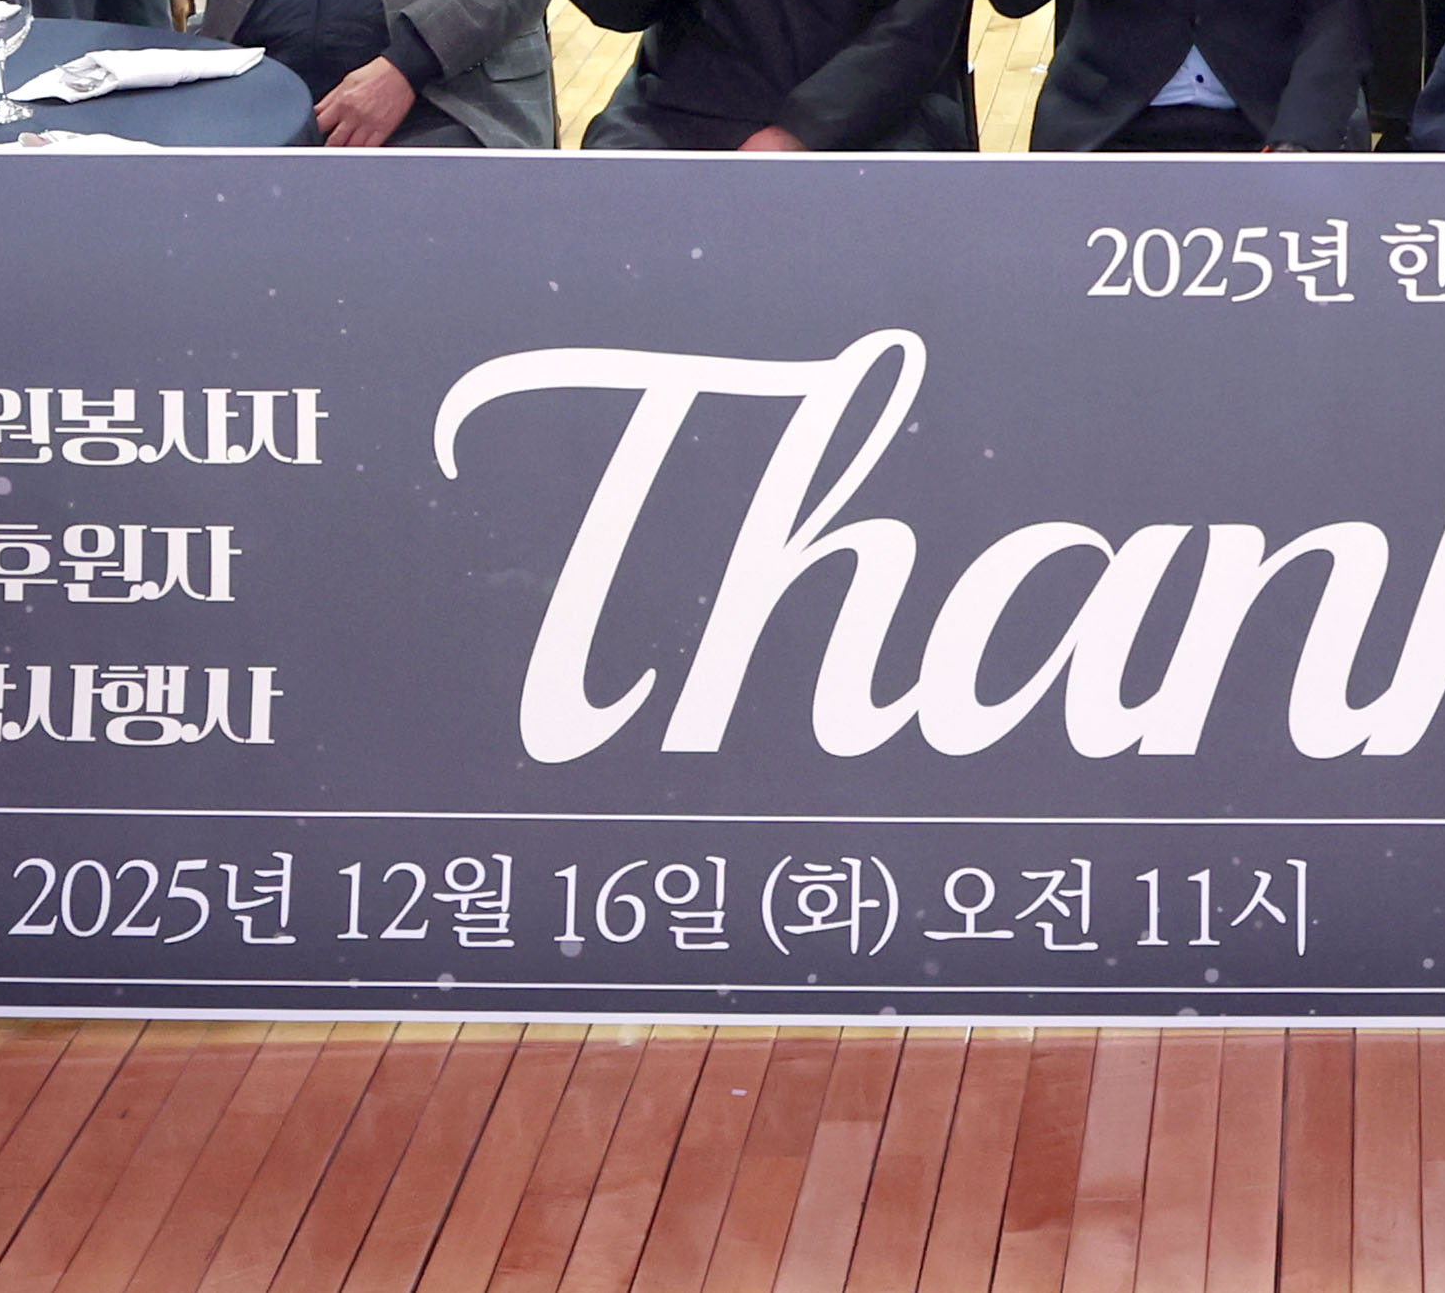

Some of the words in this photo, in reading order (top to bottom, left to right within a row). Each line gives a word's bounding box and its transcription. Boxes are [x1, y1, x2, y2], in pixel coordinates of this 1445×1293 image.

[1087, 219, 1354, 302] 2025년
[9, 852, 296, 944] 2025년
[338, 854, 515, 947] 12월
[554, 856, 730, 950] 16일
[761, 855, 899, 956] (화)
[924, 859, 1099, 950] 오전
[1137, 859, 1307, 955] 11시
